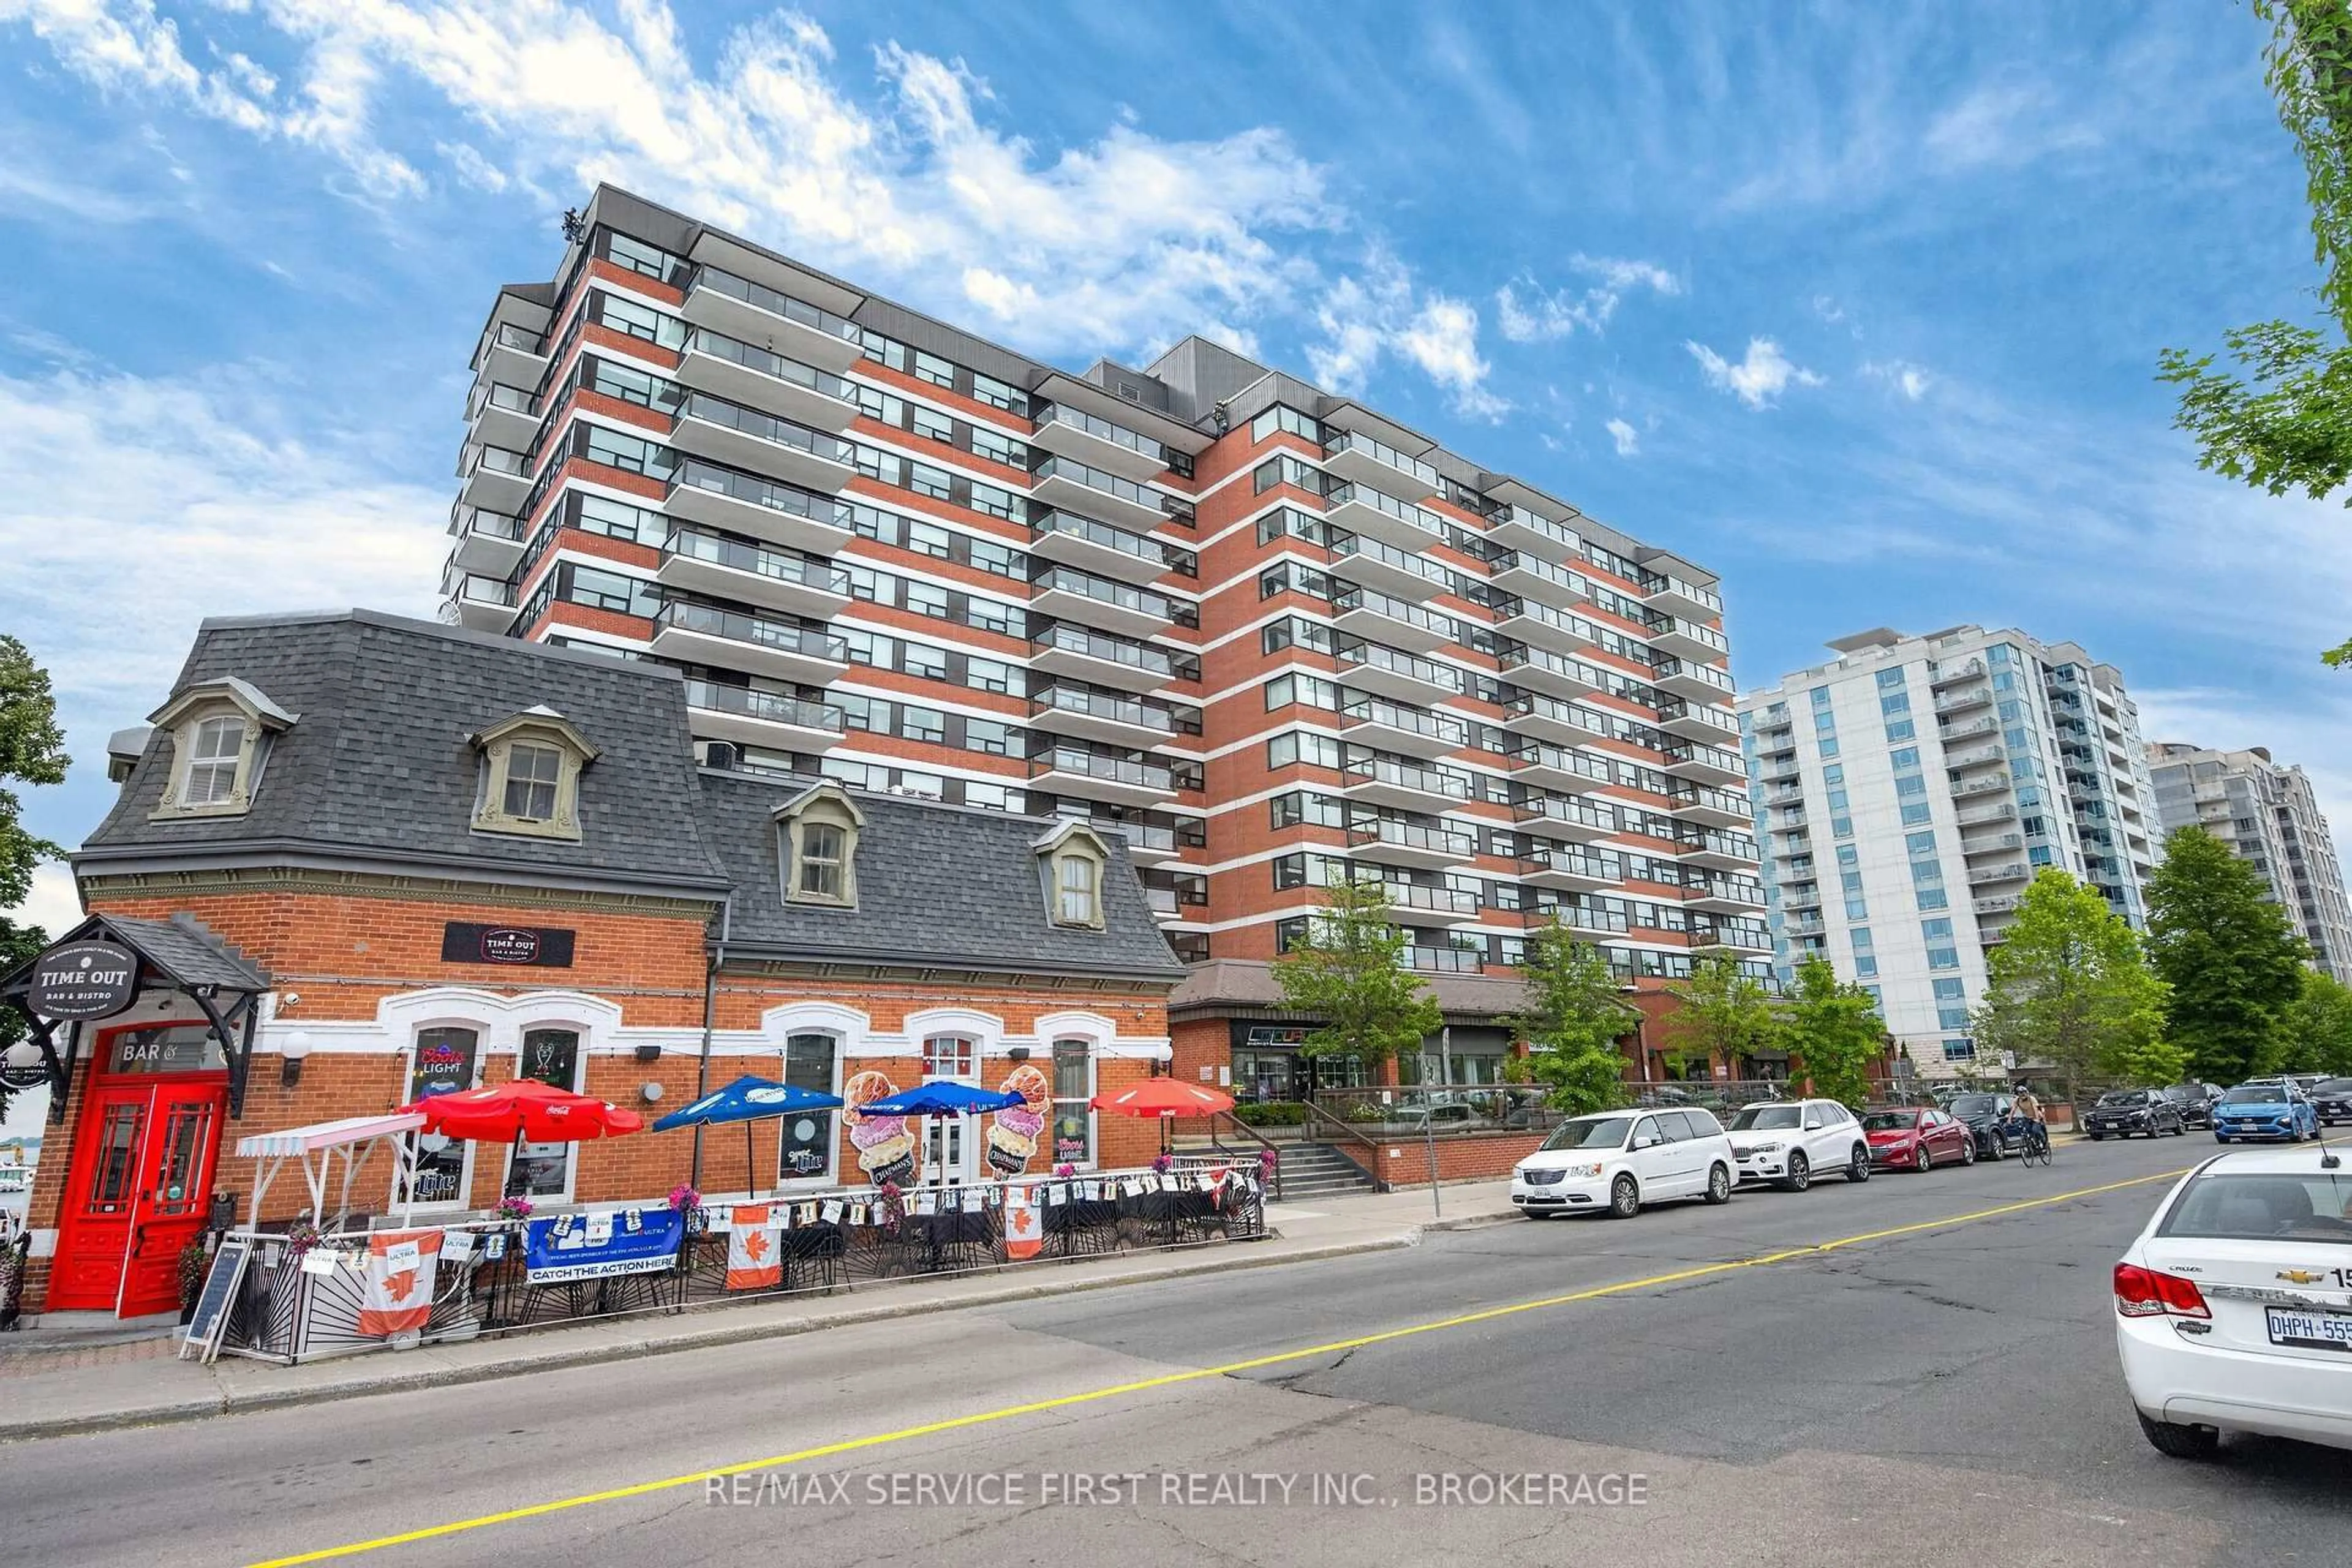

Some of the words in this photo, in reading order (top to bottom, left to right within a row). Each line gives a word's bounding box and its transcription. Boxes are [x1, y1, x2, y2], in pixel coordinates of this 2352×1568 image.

[516, 941, 535, 950] OUT
[41, 971, 86, 987] TIME
[91, 971, 127, 986] OUT
[123, 1044, 160, 1061] BAR
[423, 1063, 461, 1073] LIGHT
[389, 1250, 415, 1261] ULTRA
[533, 1270, 575, 1280] CATCH
[576, 1266, 598, 1277] THE
[600, 1261, 644, 1273] ACTION
[2271, 1316, 2313, 1337] DHPH
